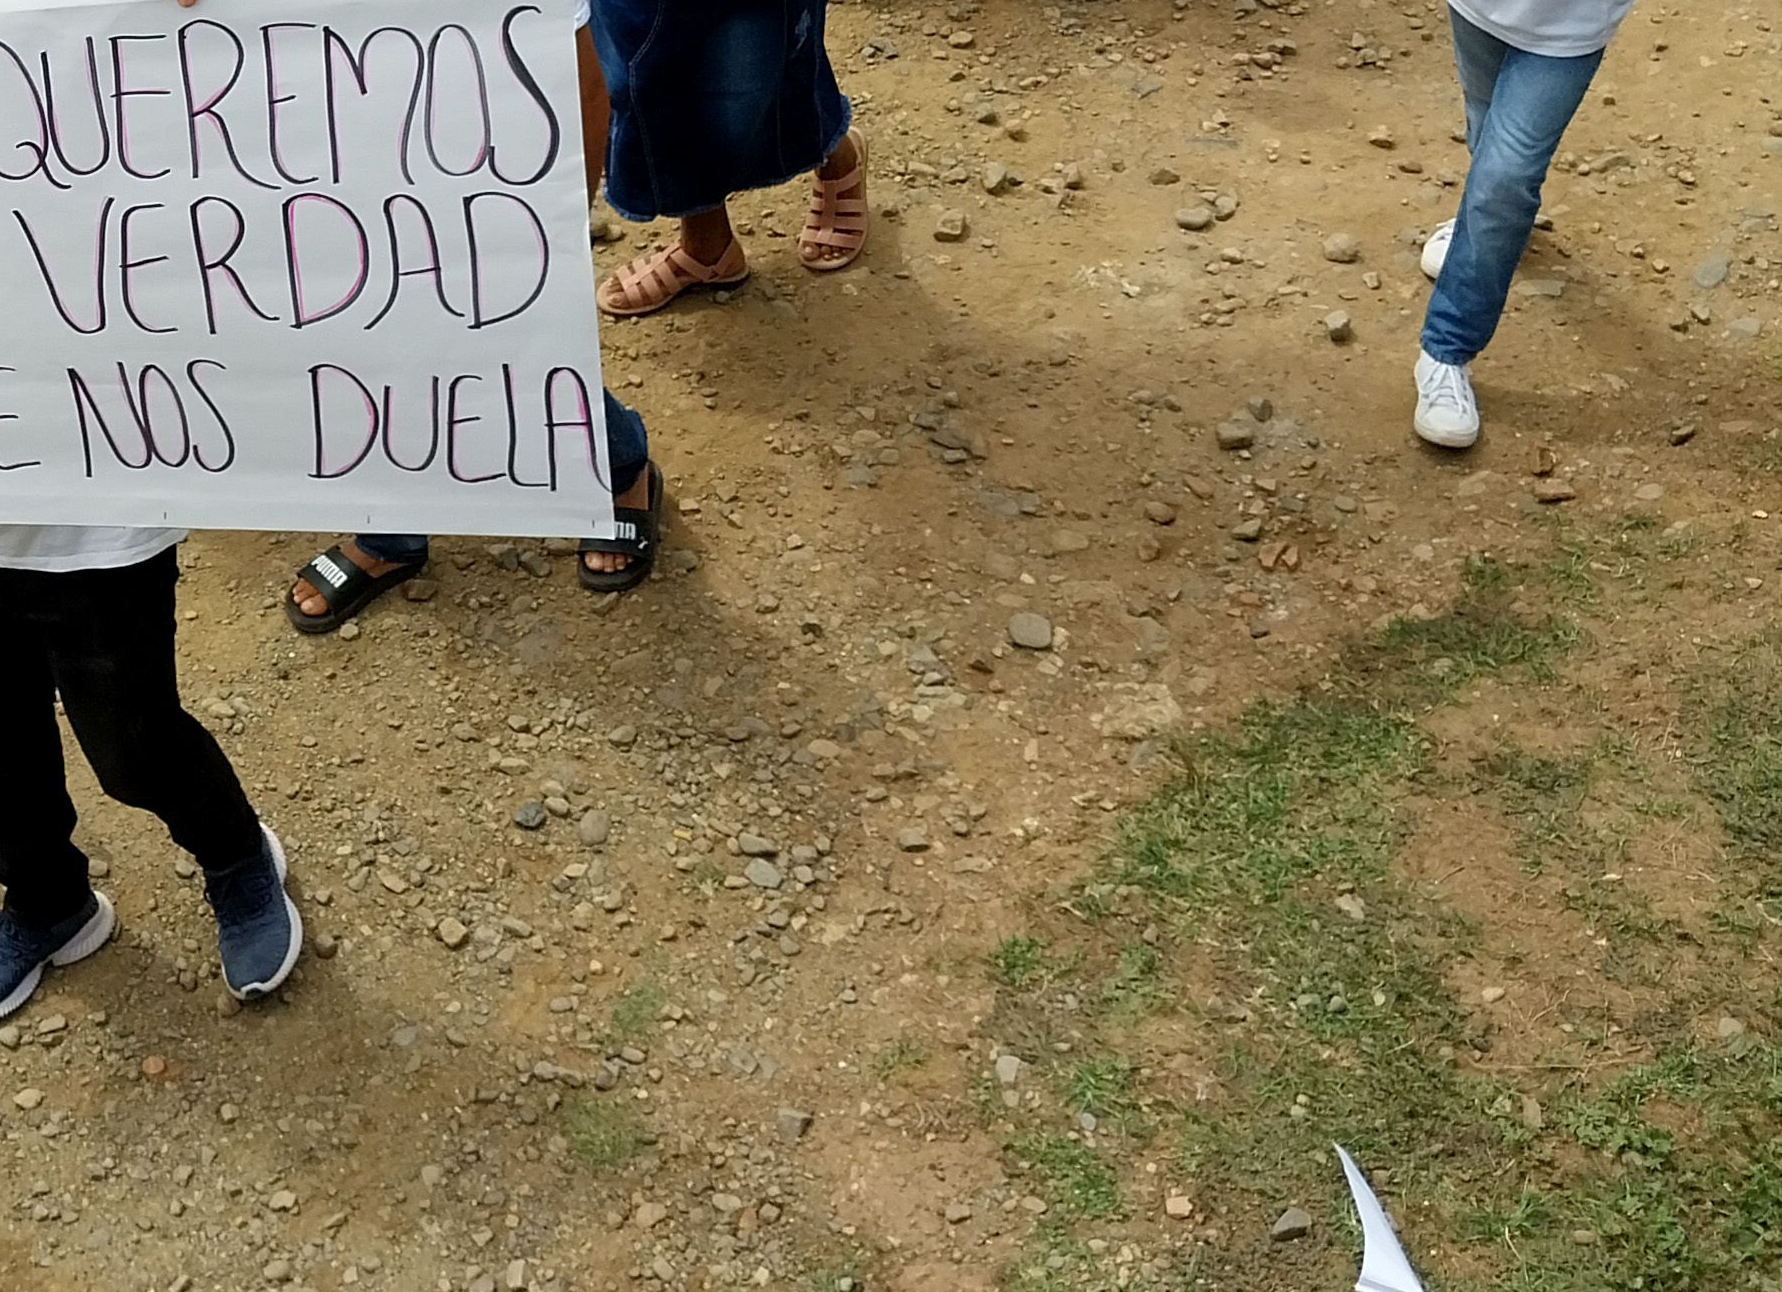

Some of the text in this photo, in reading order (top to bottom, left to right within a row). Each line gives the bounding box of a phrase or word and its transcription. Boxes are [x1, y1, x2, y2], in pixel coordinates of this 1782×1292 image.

[13, 191, 549, 335] VERDAD
[68, 360, 236, 478] NOS
[308, 363, 614, 493] DUELA
[311, 554, 348, 588] PUMA
